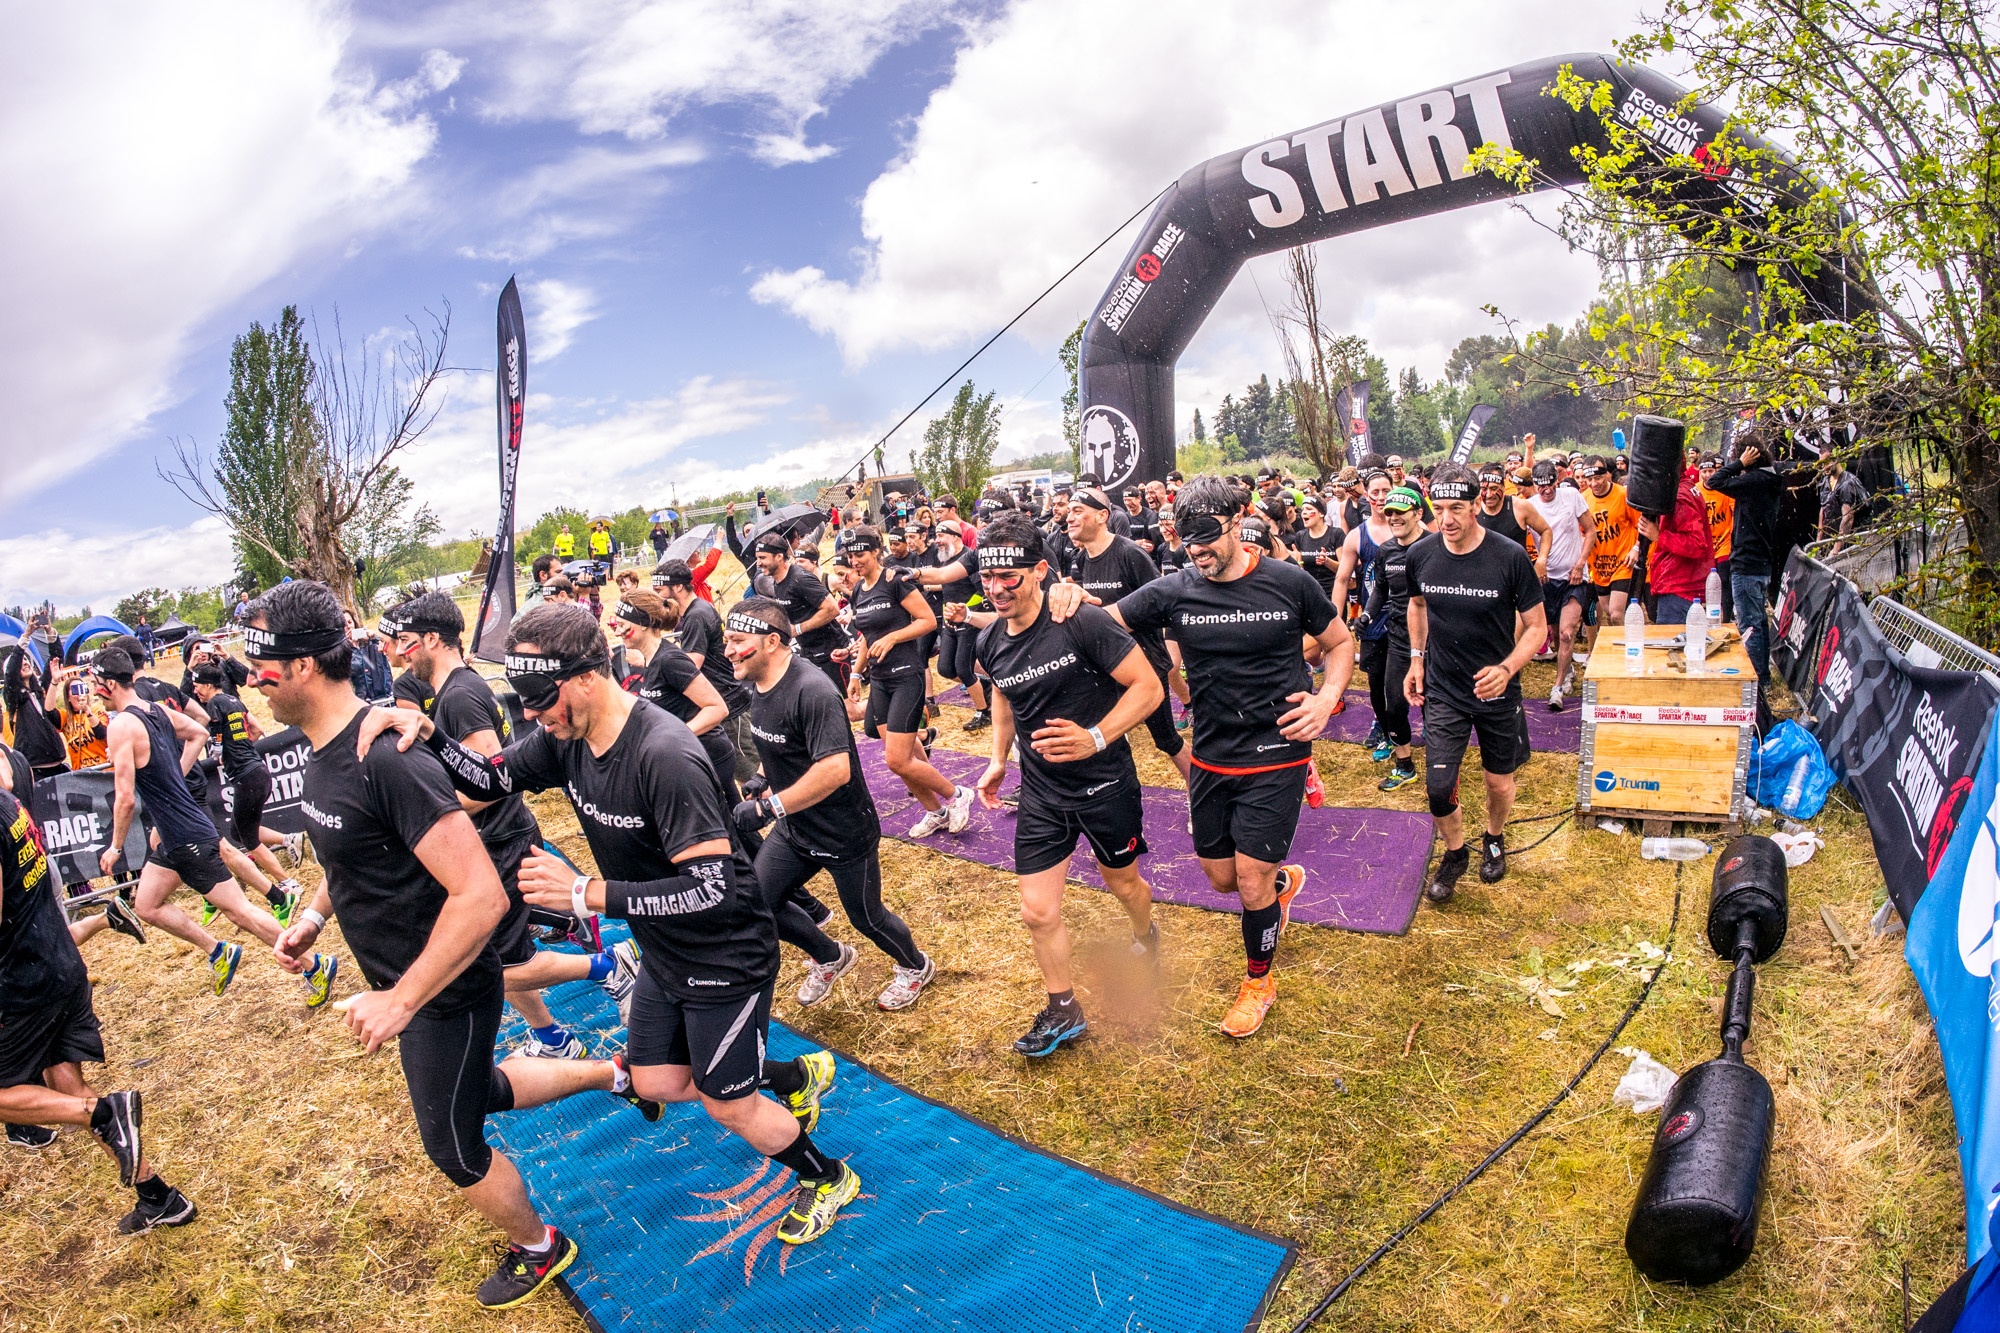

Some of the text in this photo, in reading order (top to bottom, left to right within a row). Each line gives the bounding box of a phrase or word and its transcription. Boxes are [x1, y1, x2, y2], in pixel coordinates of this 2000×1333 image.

[1627, 88, 1704, 141] Reebok
[1242, 71, 1513, 228] START
[1100, 271, 1136, 323] Reebok
[1106, 222, 1183, 333] SPARTAN RACE
[1453, 419, 1482, 466] START
[1595, 523, 1621, 547] EAM
[981, 556, 1014, 567] 13444
[1420, 582, 1499, 598] #somosheroes
[1181, 609, 1289, 626] #somosheroes
[1824, 649, 1853, 704] RACE
[1594, 711, 1642, 720] SPARTAN RACE
[1658, 713, 1682, 721] SPARTAN
[1723, 714, 1747, 722] SPARTAN
[1912, 690, 1959, 778] Reebok
[217, 744, 312, 786] Rbok
[1896, 734, 1944, 838] SPARTAN
[44, 813, 104, 850] RACE
